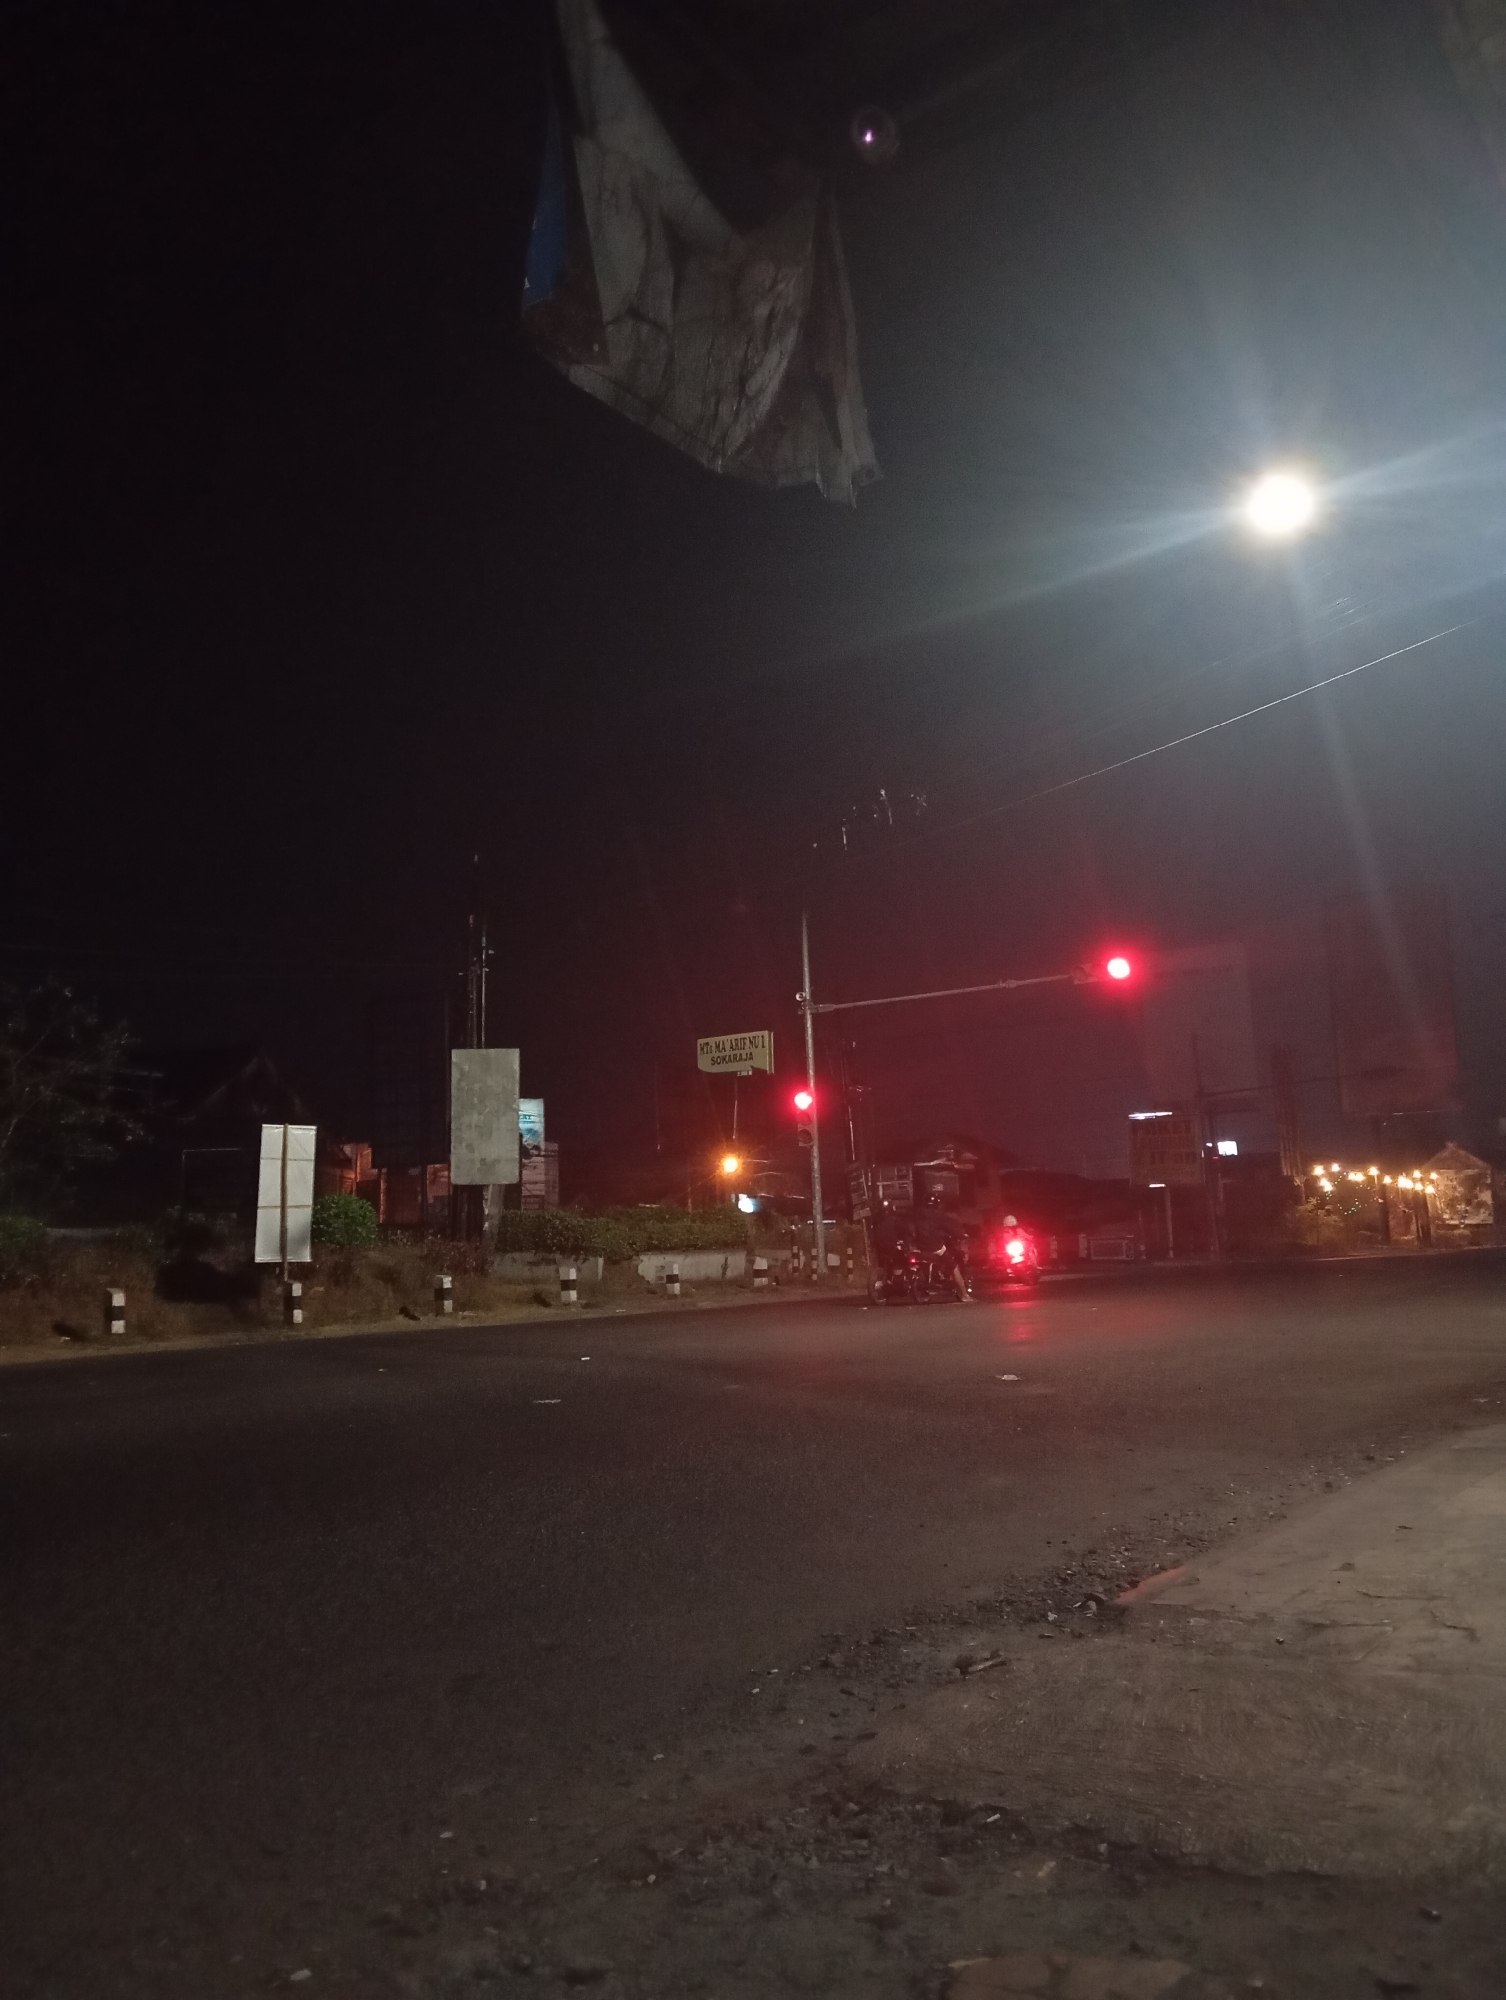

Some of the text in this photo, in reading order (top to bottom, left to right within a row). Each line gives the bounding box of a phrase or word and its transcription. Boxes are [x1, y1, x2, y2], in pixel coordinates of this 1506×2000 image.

[715, 1036, 747, 1052] MA'ARIF
[748, 1035, 760, 1049] NU
[761, 1035, 766, 1048] 1
[711, 1052, 753, 1065] SOKARAJA
